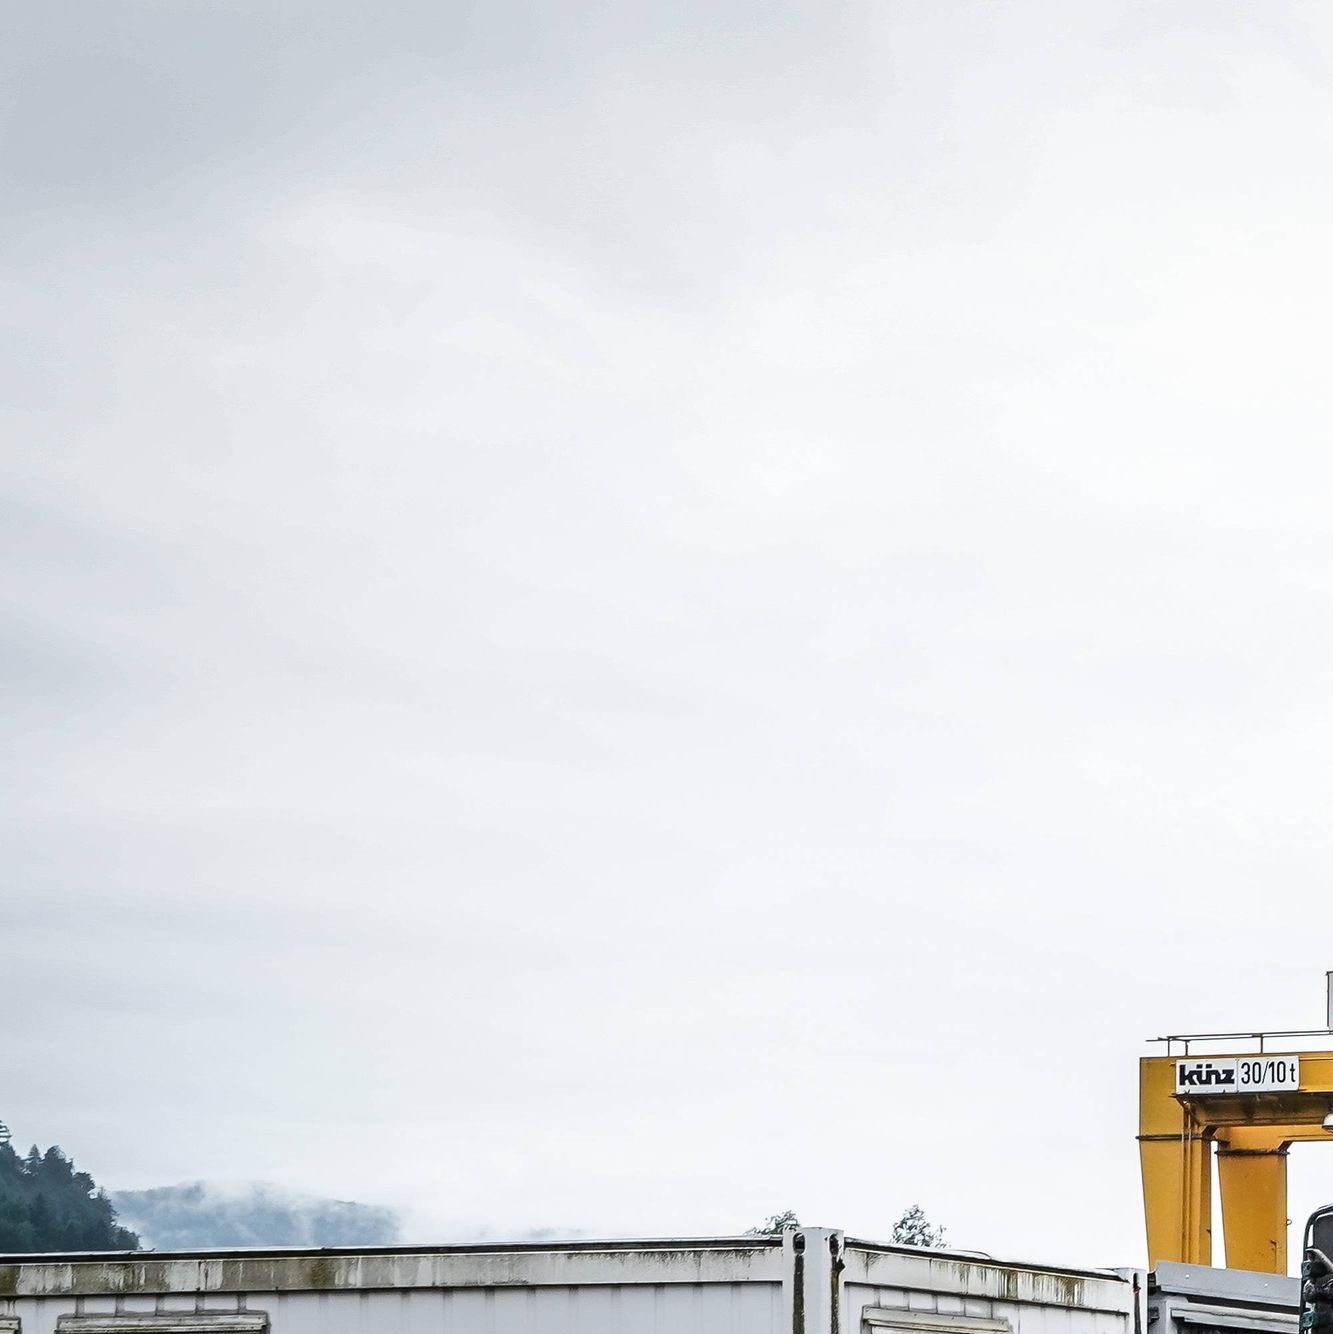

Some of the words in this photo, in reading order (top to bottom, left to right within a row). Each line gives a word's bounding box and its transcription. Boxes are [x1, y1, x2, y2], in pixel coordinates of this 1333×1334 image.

[1179, 1063, 1235, 1086] künz
[1241, 1061, 1286, 1084] 30/10
[1290, 1063, 1296, 1082] t
